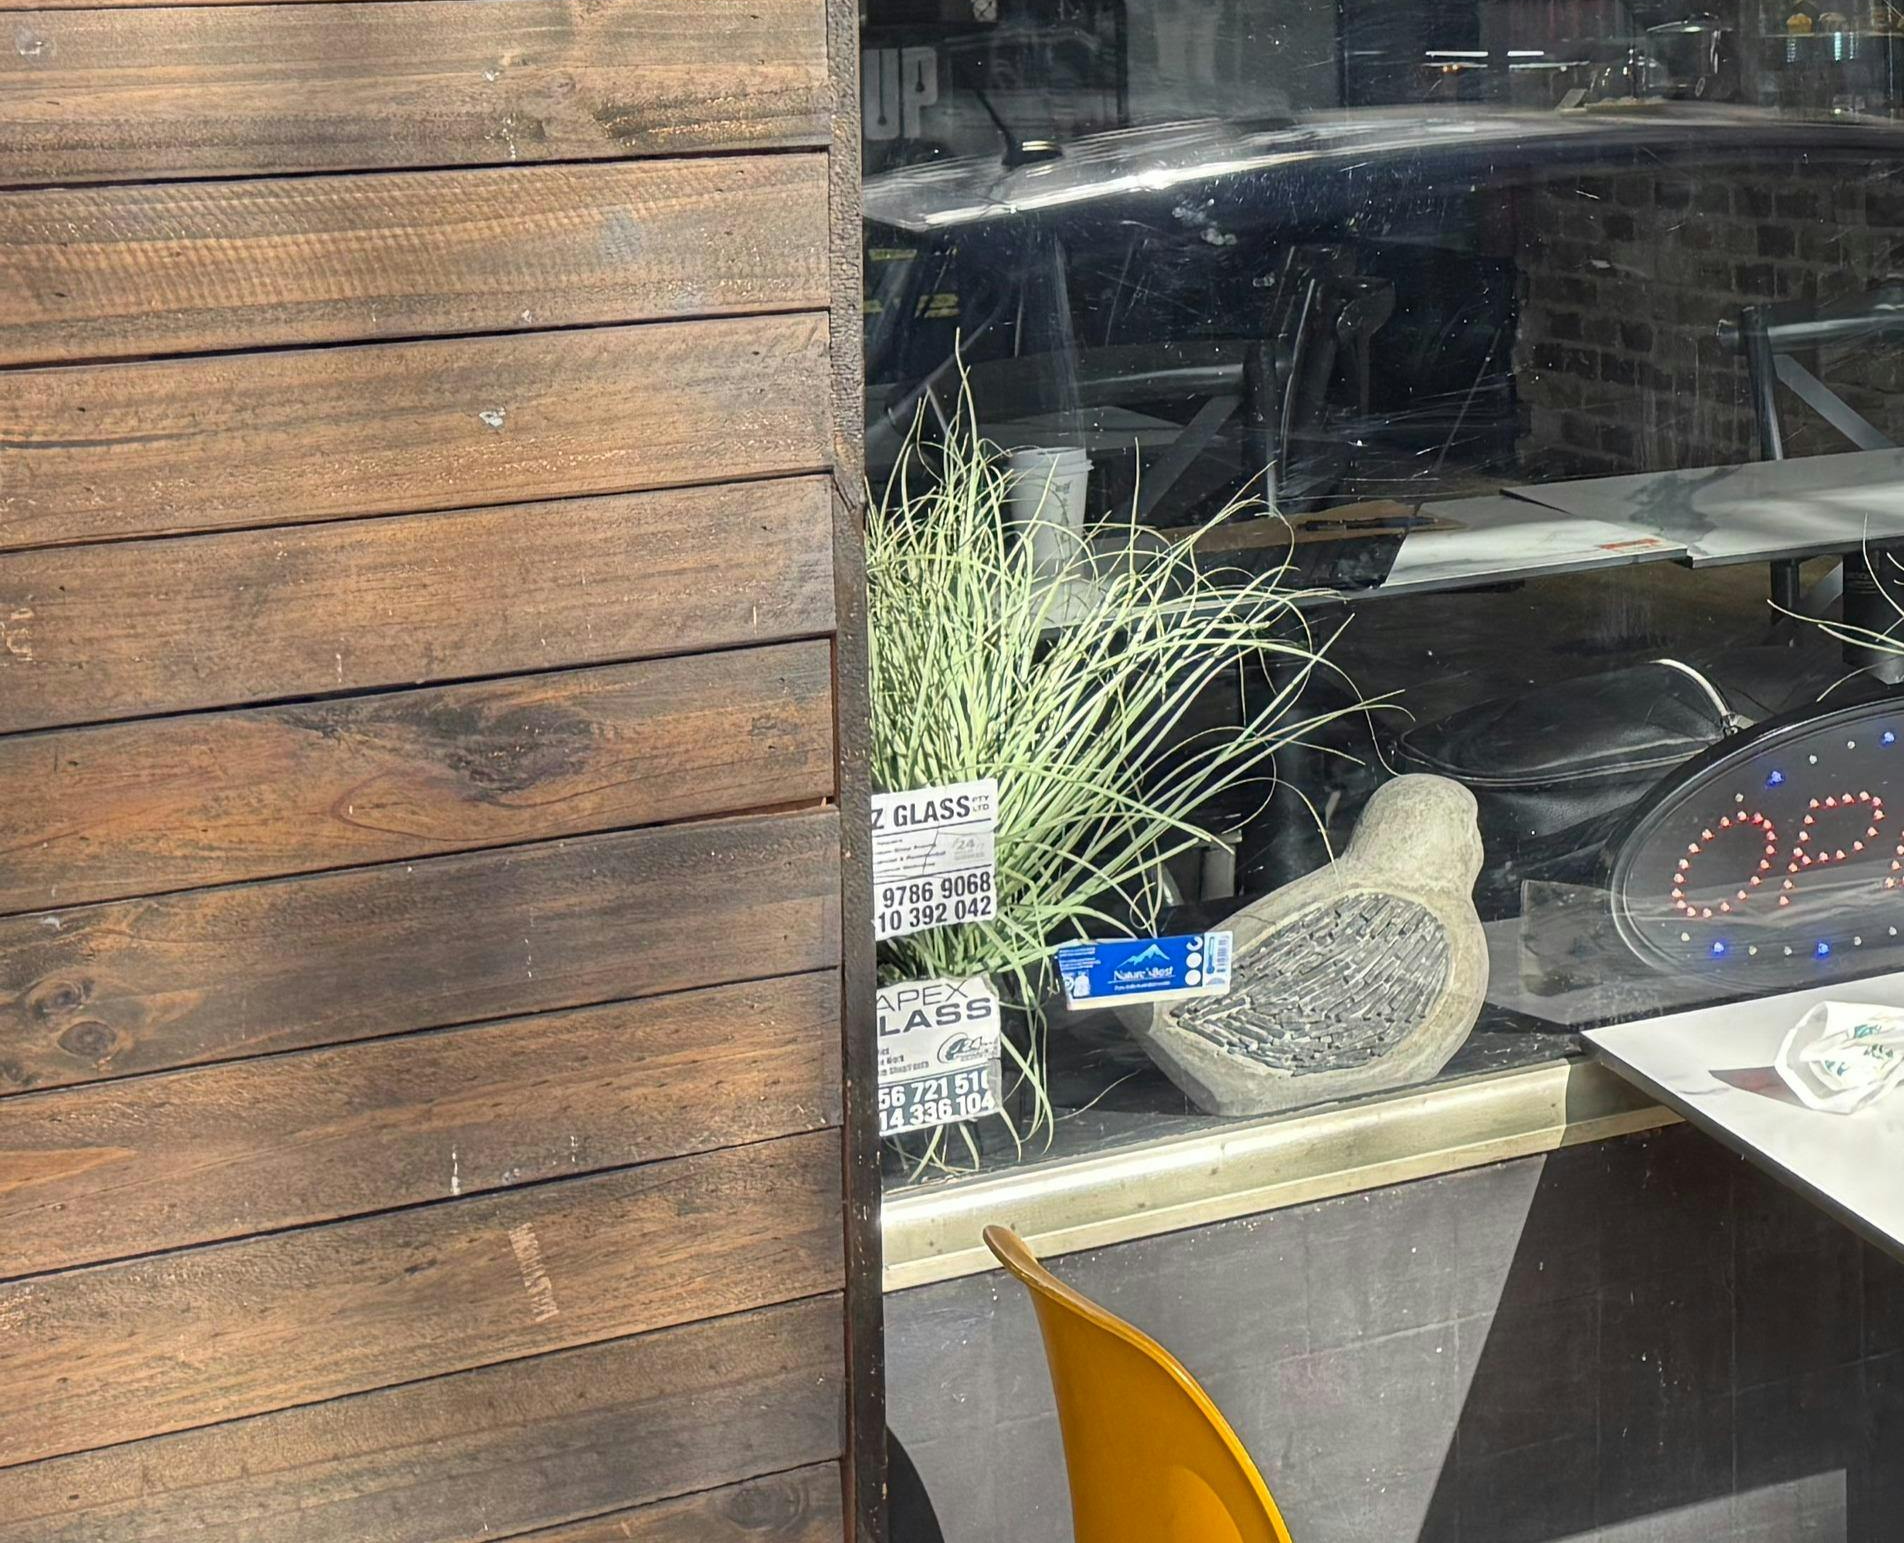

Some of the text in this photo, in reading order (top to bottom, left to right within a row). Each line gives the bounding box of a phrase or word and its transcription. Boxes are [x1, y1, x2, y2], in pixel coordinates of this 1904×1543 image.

[893, 795, 970, 827] GLASS
[972, 794, 989, 803] PTY
[972, 804, 989, 812] LTD
[882, 871, 991, 909] 9786 9068
[909, 903, 947, 928] 392
[954, 895, 991, 920] 042
[877, 980, 968, 1012] APEX
[879, 998, 991, 1036] LASS
[910, 1077, 949, 1103] 721
[910, 1098, 952, 1125] 336
[956, 1090, 995, 1117] 104
